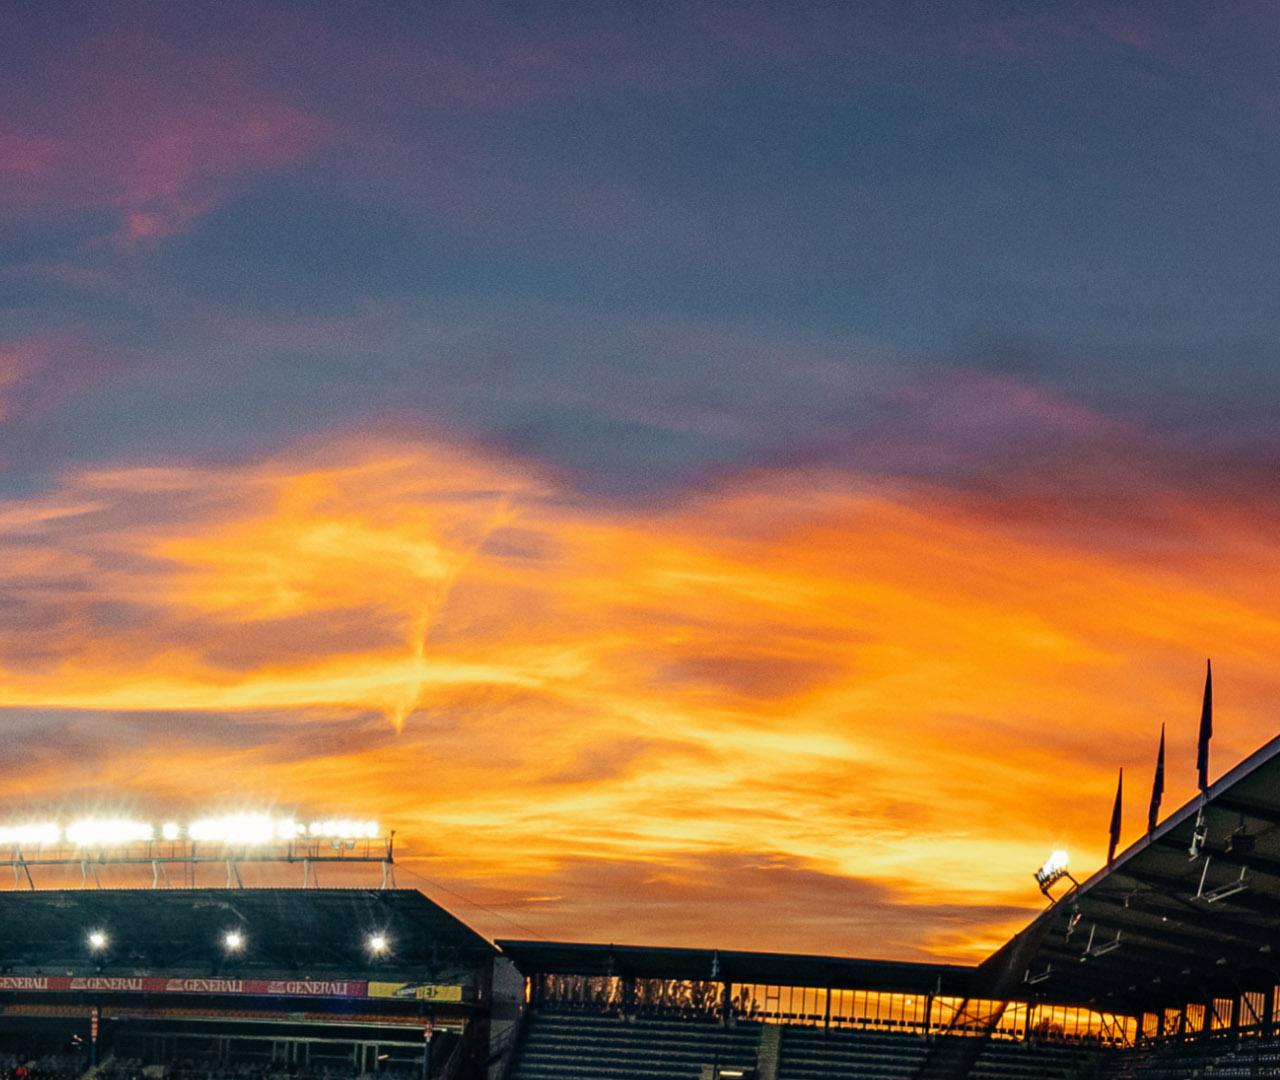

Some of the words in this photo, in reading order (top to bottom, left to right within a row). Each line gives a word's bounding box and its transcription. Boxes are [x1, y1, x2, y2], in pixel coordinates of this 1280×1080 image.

[87, 978, 142, 990] GENERALI
[184, 979, 242, 992] GENERALI
[286, 981, 348, 995] GENERALI
